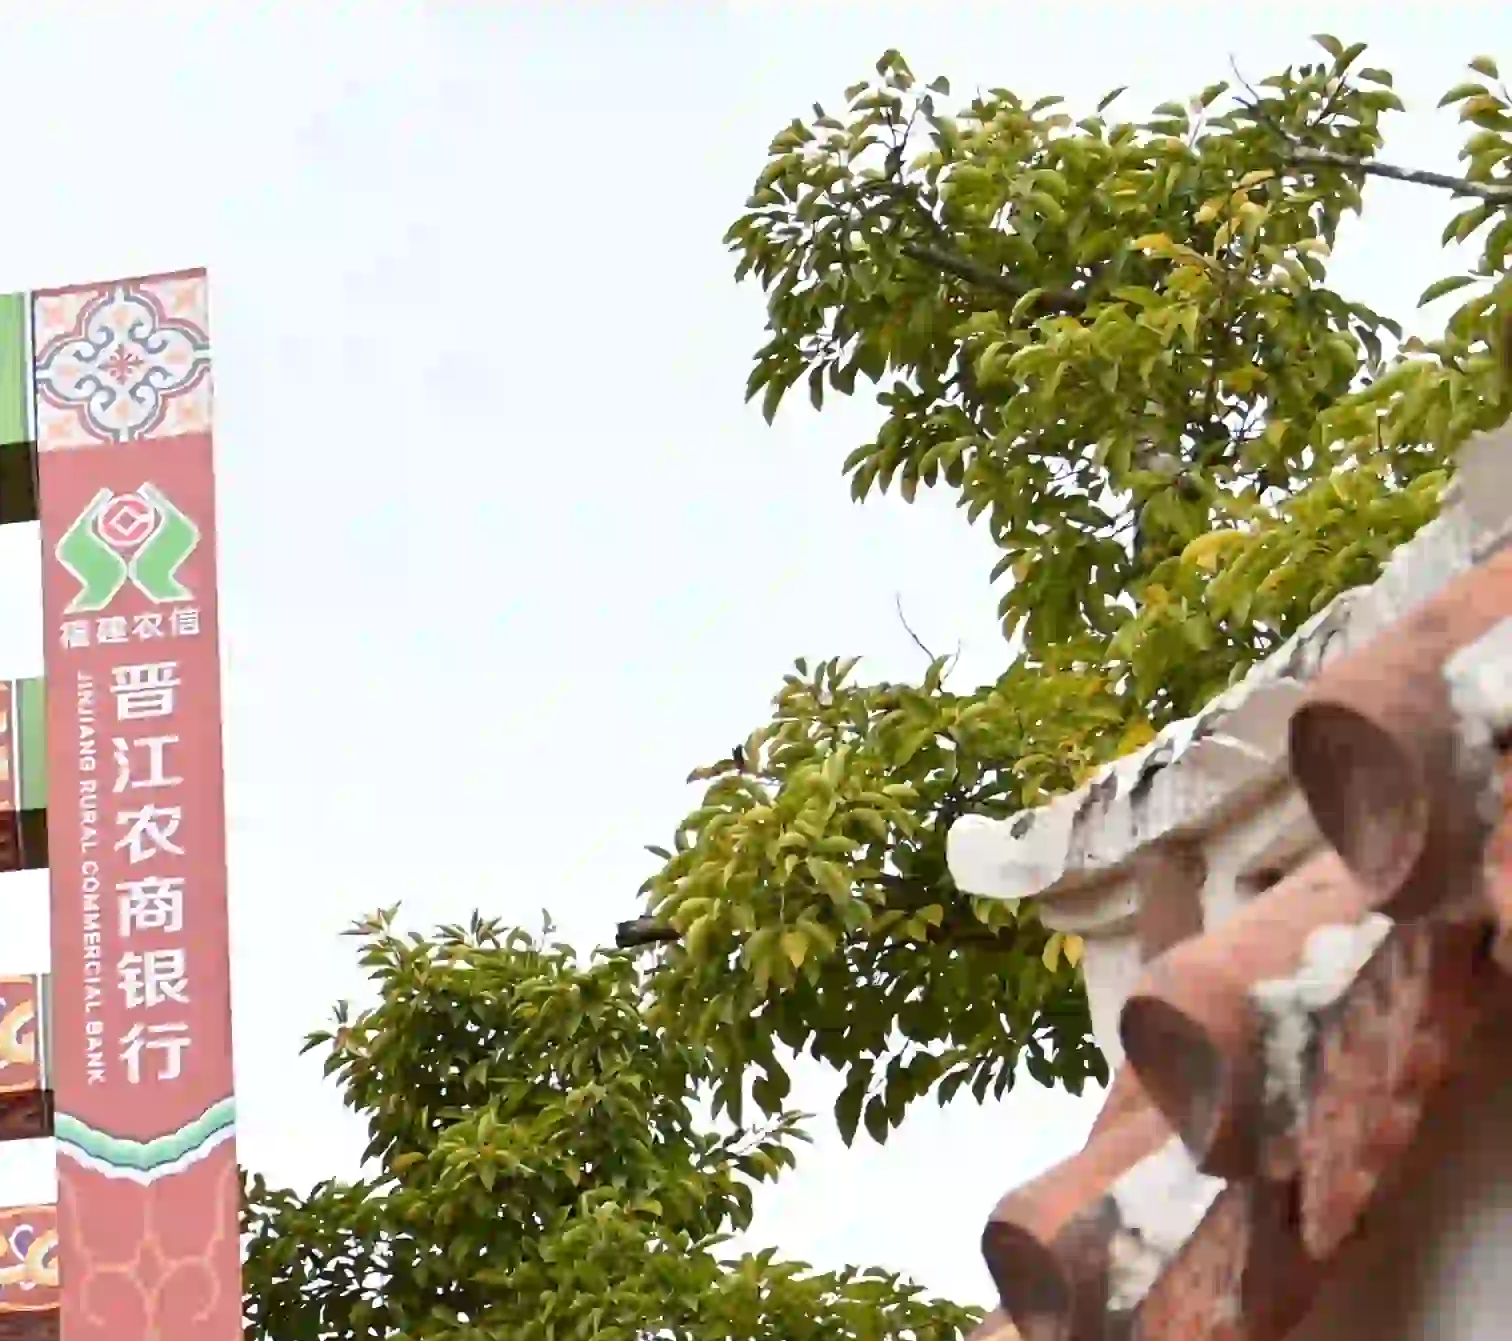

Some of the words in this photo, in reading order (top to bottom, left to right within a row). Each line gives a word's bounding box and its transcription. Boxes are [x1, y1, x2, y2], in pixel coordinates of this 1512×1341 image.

[61, 606, 200, 649] 福建农信
[77, 671, 96, 770] JINJIANG
[79, 780, 97, 852] RURAL
[111, 661, 191, 1084] 晋江农商银行
[81, 861, 102, 1012] COMMERCIAL
[85, 1021, 105, 1083] BANK
